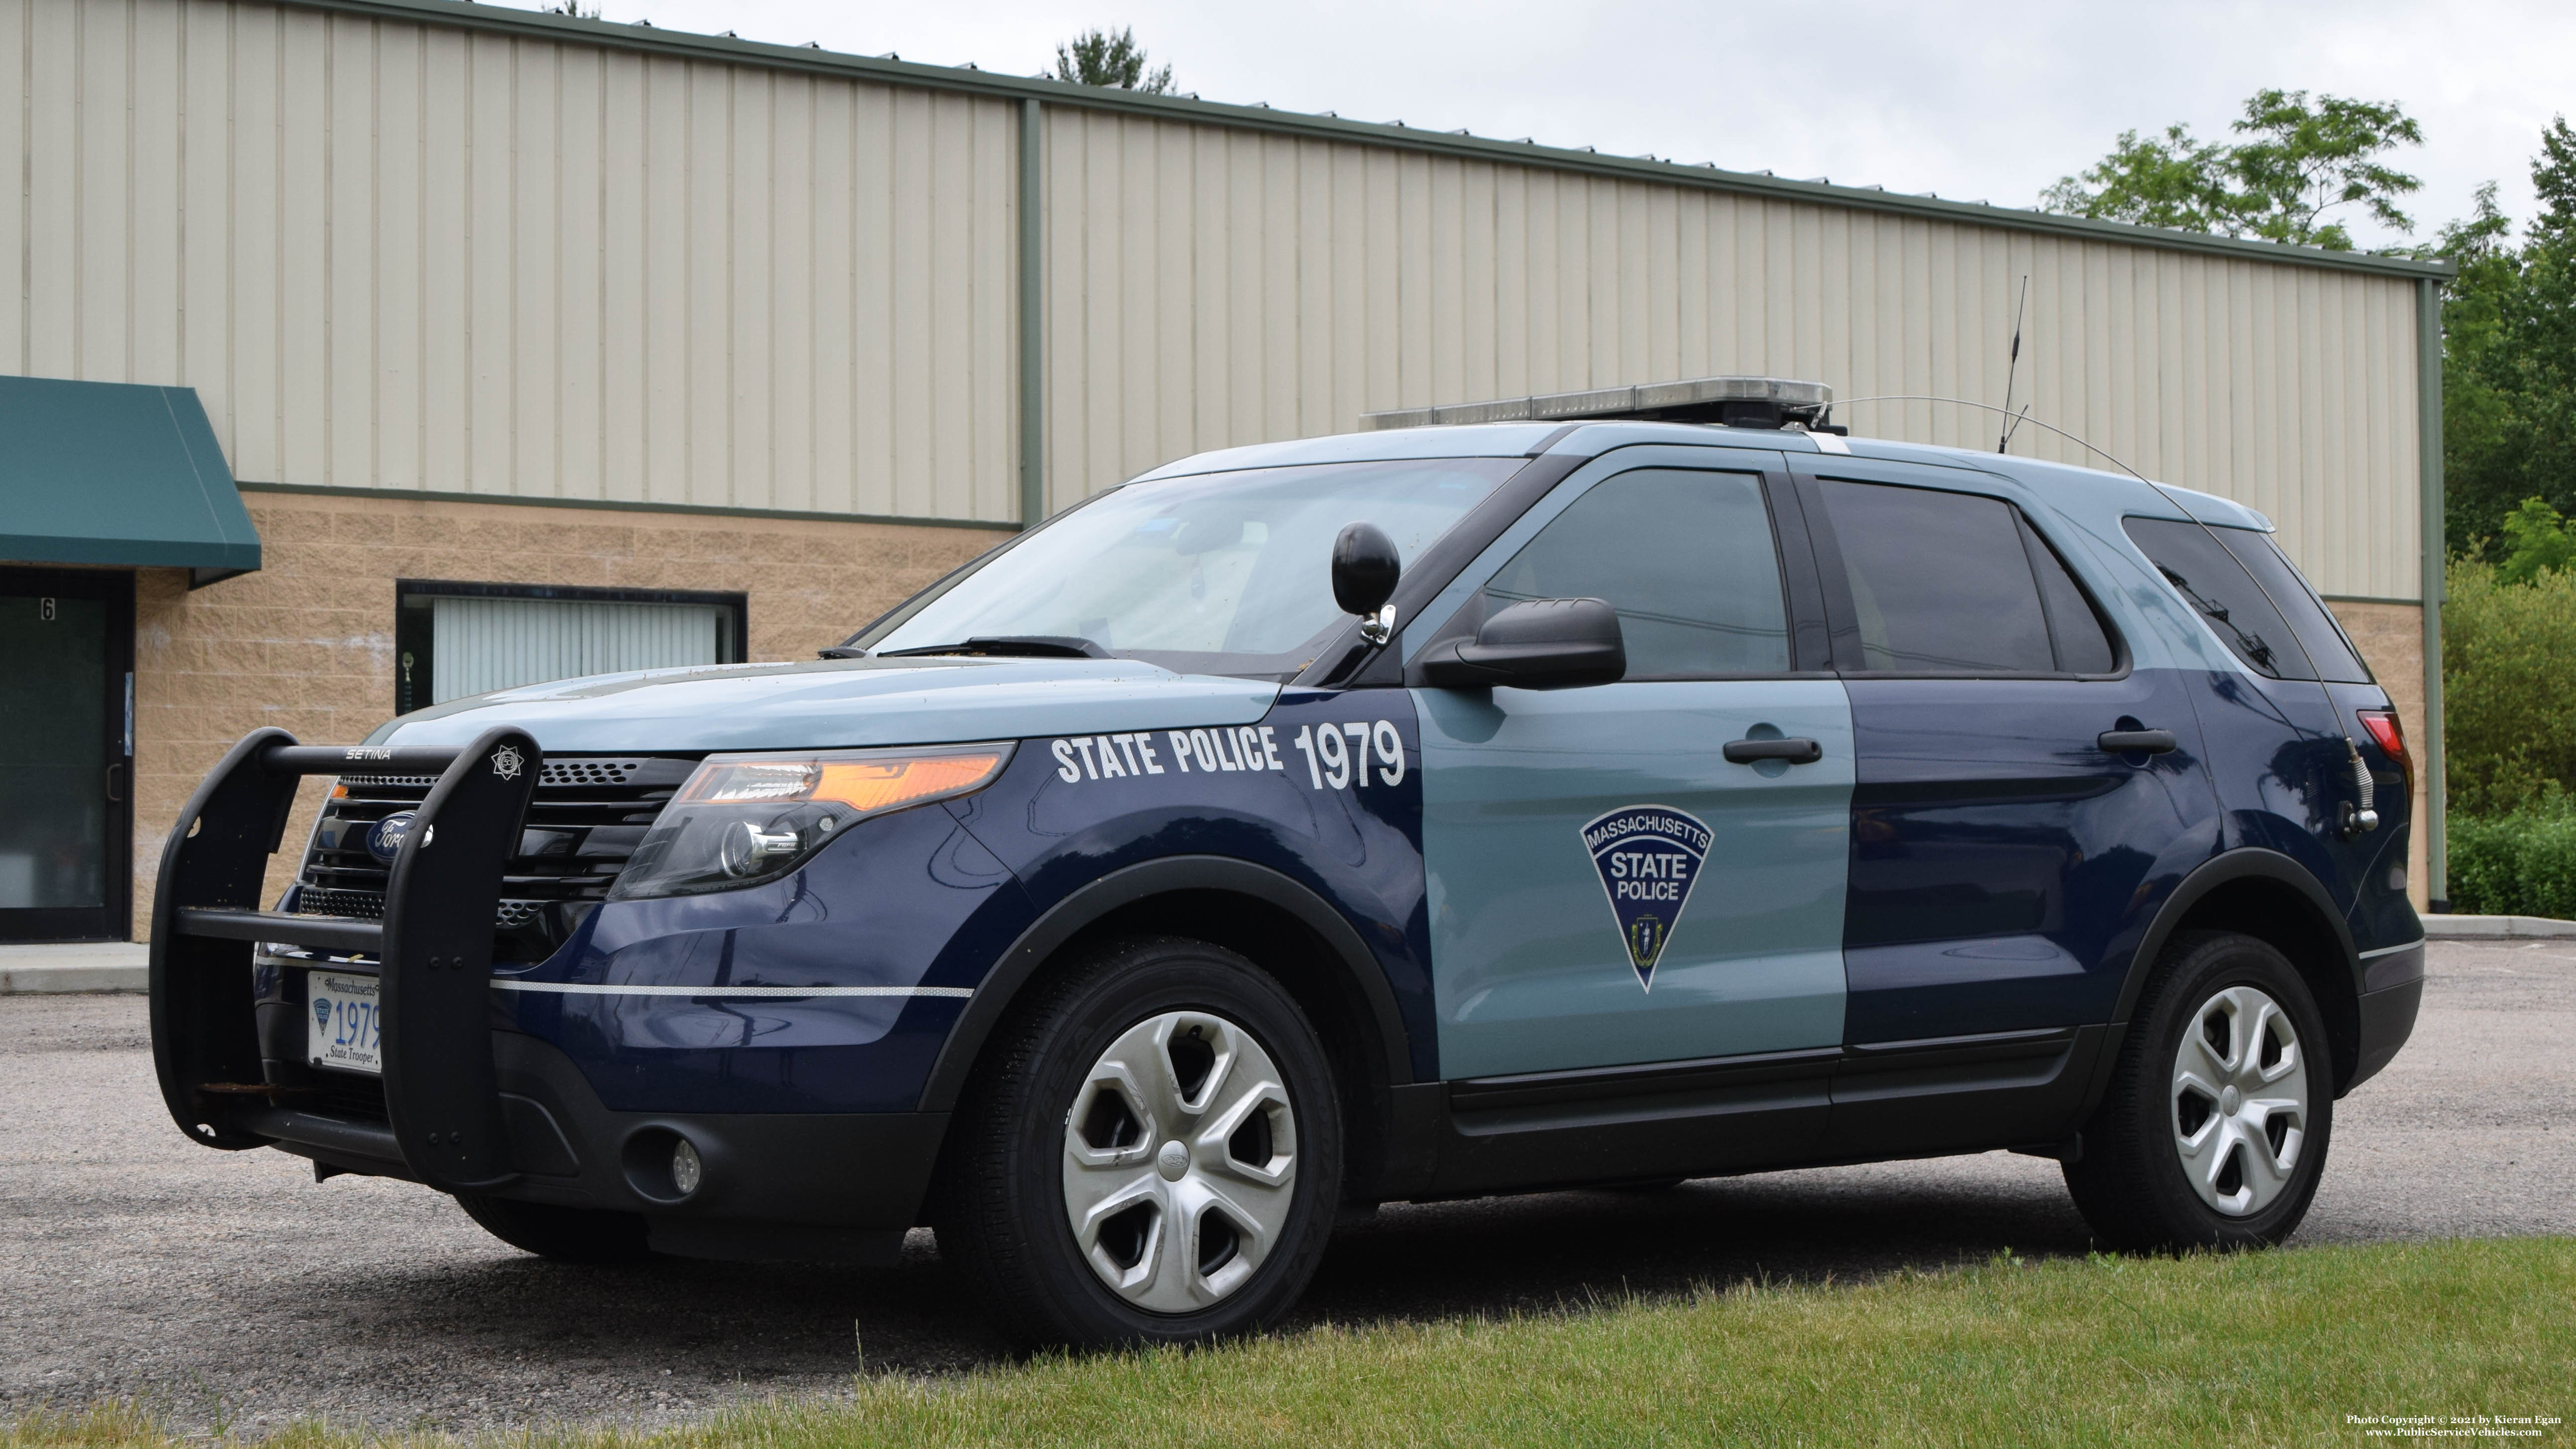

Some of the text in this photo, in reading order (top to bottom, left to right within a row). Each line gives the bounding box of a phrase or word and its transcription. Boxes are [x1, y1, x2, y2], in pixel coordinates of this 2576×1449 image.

[43, 599, 53, 620] 6
[346, 749, 391, 759] SETINA
[1052, 720, 1405, 790] STATE POLICE 1979
[1587, 816, 1709, 849] MASSACHUSETTS
[1610, 852, 1687, 879] STATE
[1617, 881, 1679, 900] POLICE
[328, 978, 375, 996] Massachusetts
[330, 1045, 373, 1064] State Trooper
